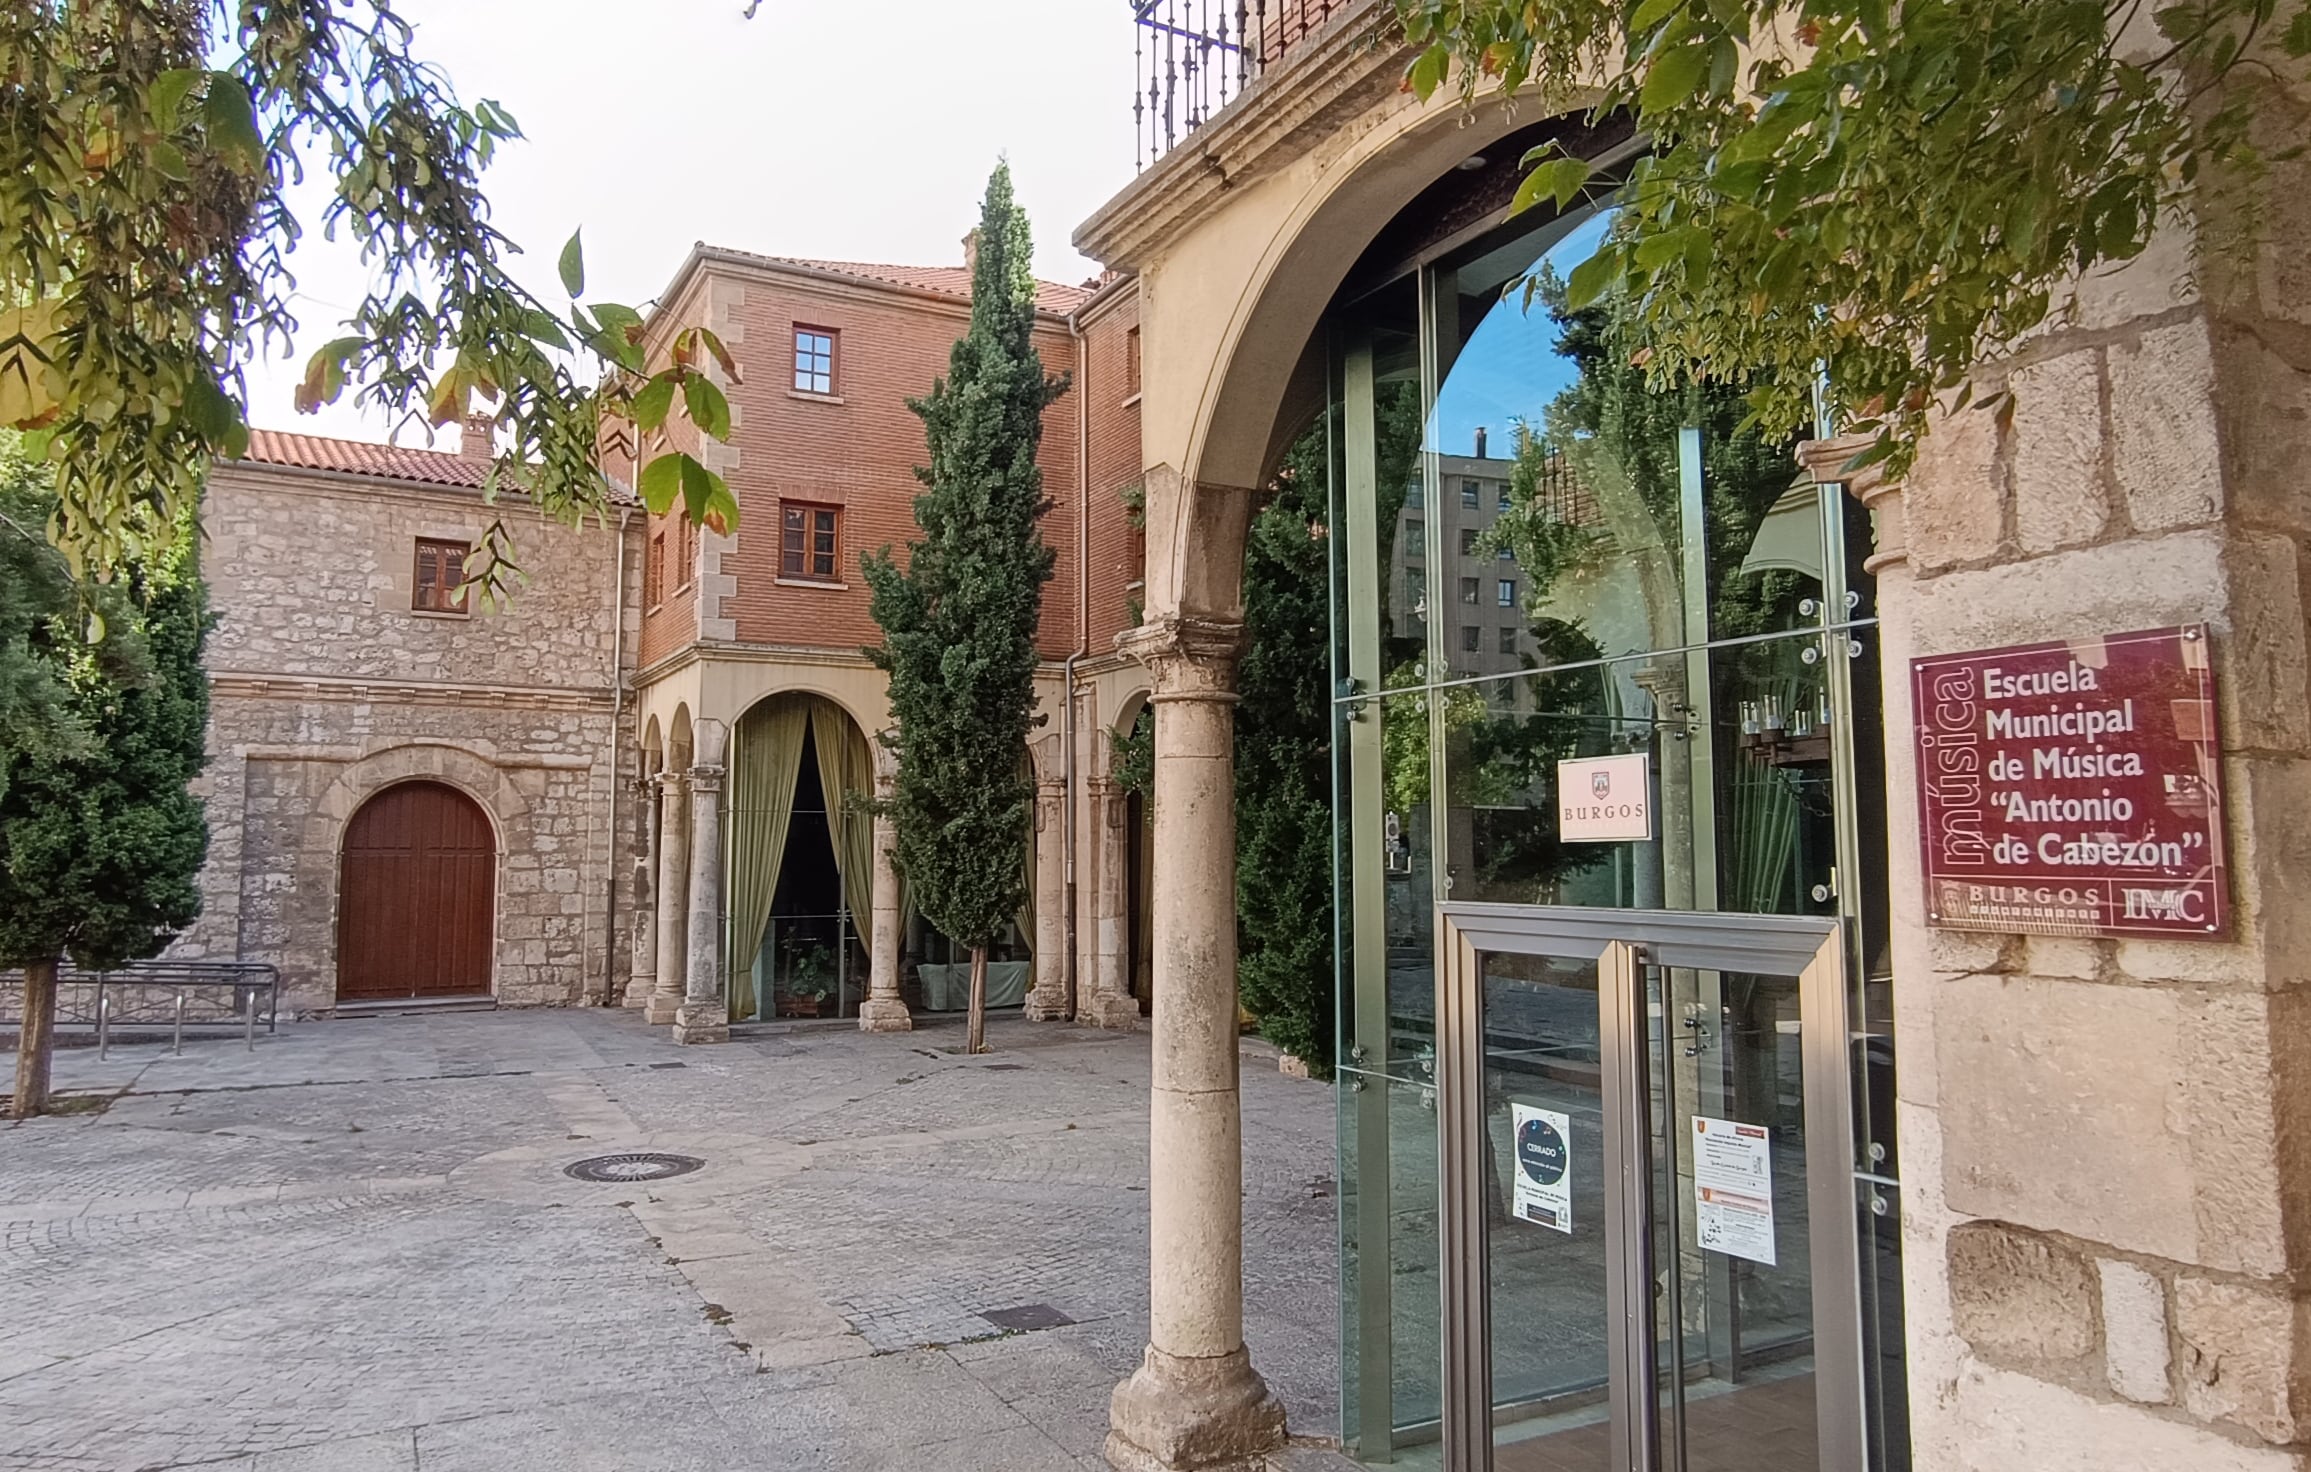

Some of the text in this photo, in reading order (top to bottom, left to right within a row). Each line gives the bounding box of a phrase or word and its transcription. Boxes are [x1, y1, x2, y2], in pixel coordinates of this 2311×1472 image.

[1983, 661, 2098, 699] Escuela
[1985, 699, 2134, 743] Municipal
[1921, 667, 1984, 865] música
[1988, 744, 2144, 781] de Música
[1564, 804, 1643, 820] BURGOS
[1990, 788, 2133, 822] “Antonio
[1993, 832, 2203, 867] de Cabezón”
[1969, 885, 2100, 906] BURGOS
[1527, 1143, 1557, 1158] CERRADO
